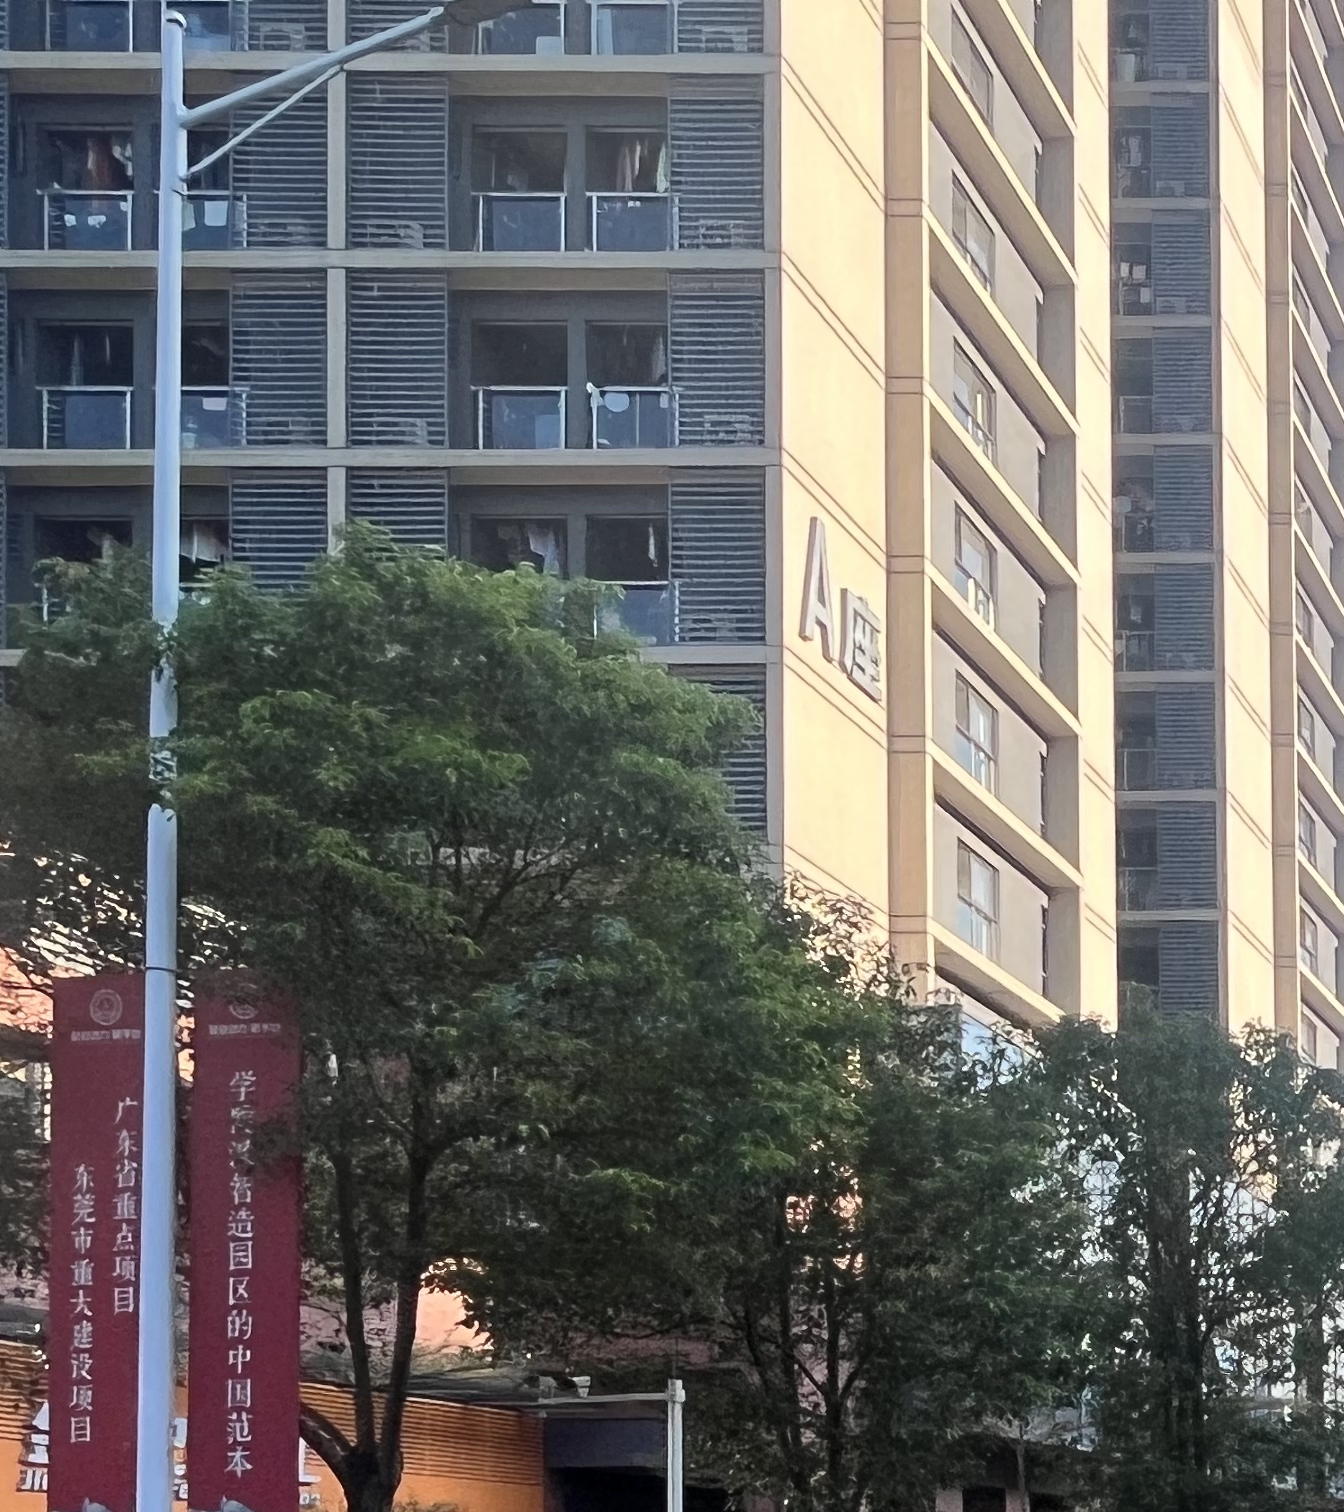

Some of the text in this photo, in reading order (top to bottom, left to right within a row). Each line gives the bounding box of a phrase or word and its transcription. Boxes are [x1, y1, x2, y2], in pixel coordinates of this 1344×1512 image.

[68, 1163, 96, 1446] 东莞市重大建设项目
[111, 1096, 140, 1316] 广东省重点项目
